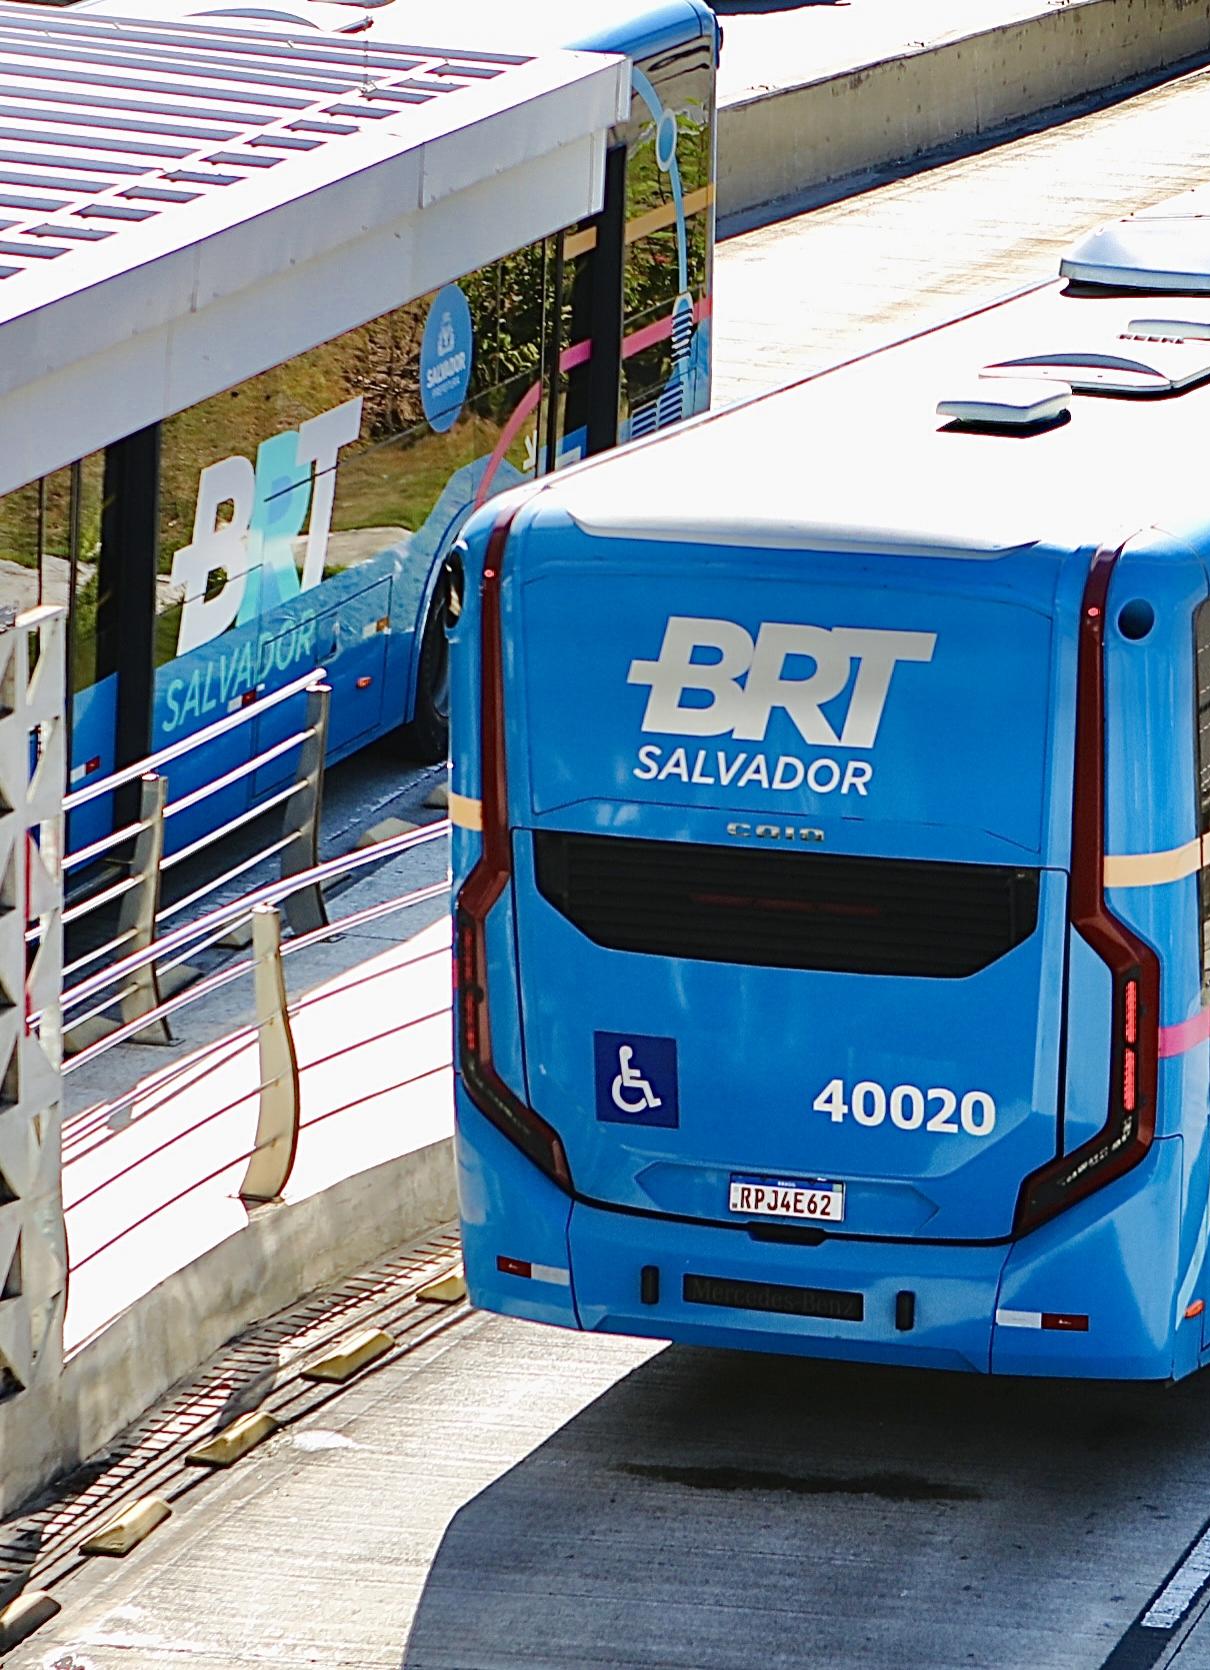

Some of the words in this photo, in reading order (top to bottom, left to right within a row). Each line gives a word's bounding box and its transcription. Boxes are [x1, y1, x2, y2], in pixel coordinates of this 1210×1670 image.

[426, 351, 466, 389] SALVADOR
[170, 396, 364, 657] BRT
[162, 608, 320, 732] SALVADOR
[626, 615, 937, 748] BRT
[633, 744, 873, 796] SALVADOR
[812, 1078, 997, 1136] 40020
[740, 1187, 832, 1217] RPJ4E62
[690, 1278, 856, 1315] Mercedes-Benz
